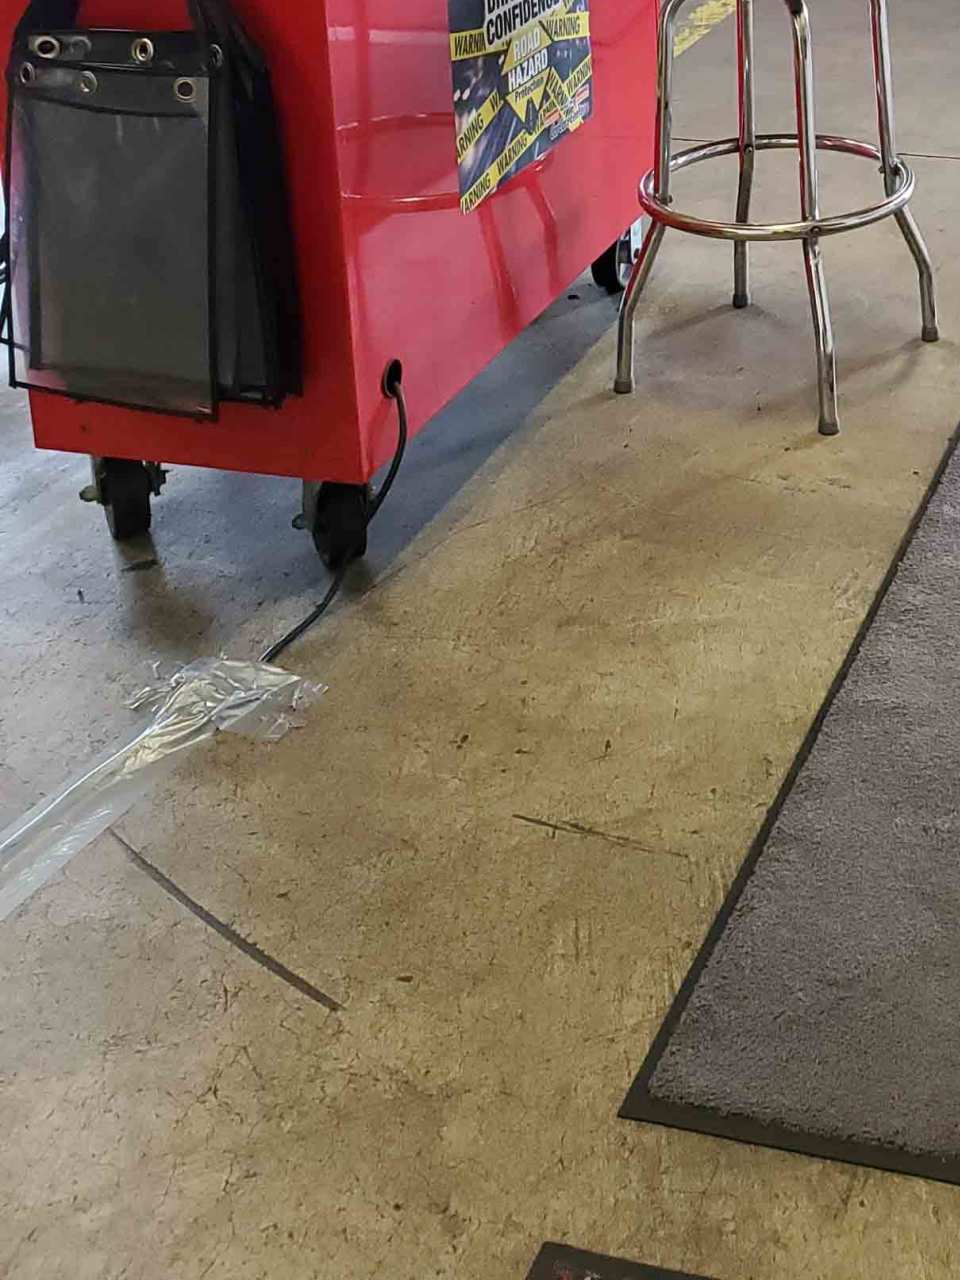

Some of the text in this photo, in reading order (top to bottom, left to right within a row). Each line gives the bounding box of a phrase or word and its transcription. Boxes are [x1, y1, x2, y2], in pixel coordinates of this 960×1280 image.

[514, 26, 541, 61] ROAD
[508, 48, 548, 92] HAZARD
[496, 134, 528, 175] WARNING
